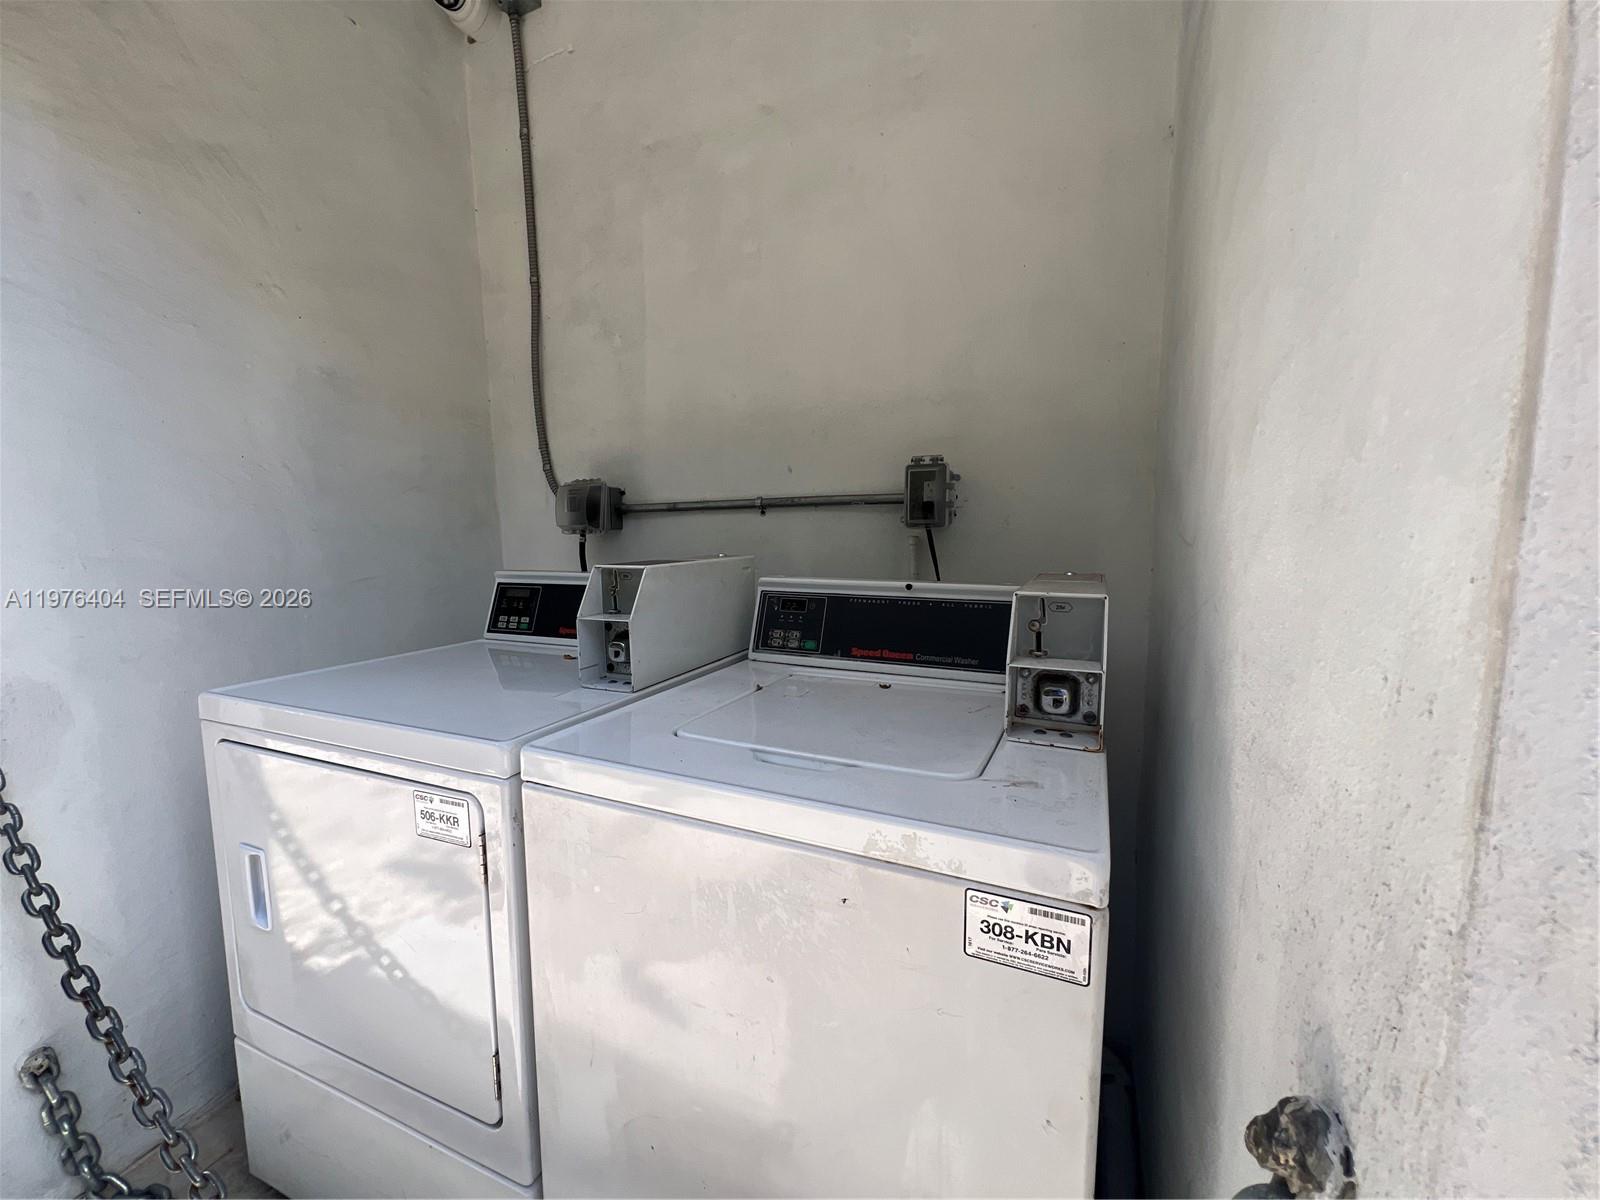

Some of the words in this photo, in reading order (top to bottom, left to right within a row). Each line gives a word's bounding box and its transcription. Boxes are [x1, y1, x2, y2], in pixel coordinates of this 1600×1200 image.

[915, 653, 953, 664] Commercial
[953, 656, 980, 666] Washer
[415, 793, 429, 802] CSC
[420, 809, 460, 828] 506-KKR
[969, 894, 1000, 908] CSC
[979, 919, 1072, 955] 308-KBN
